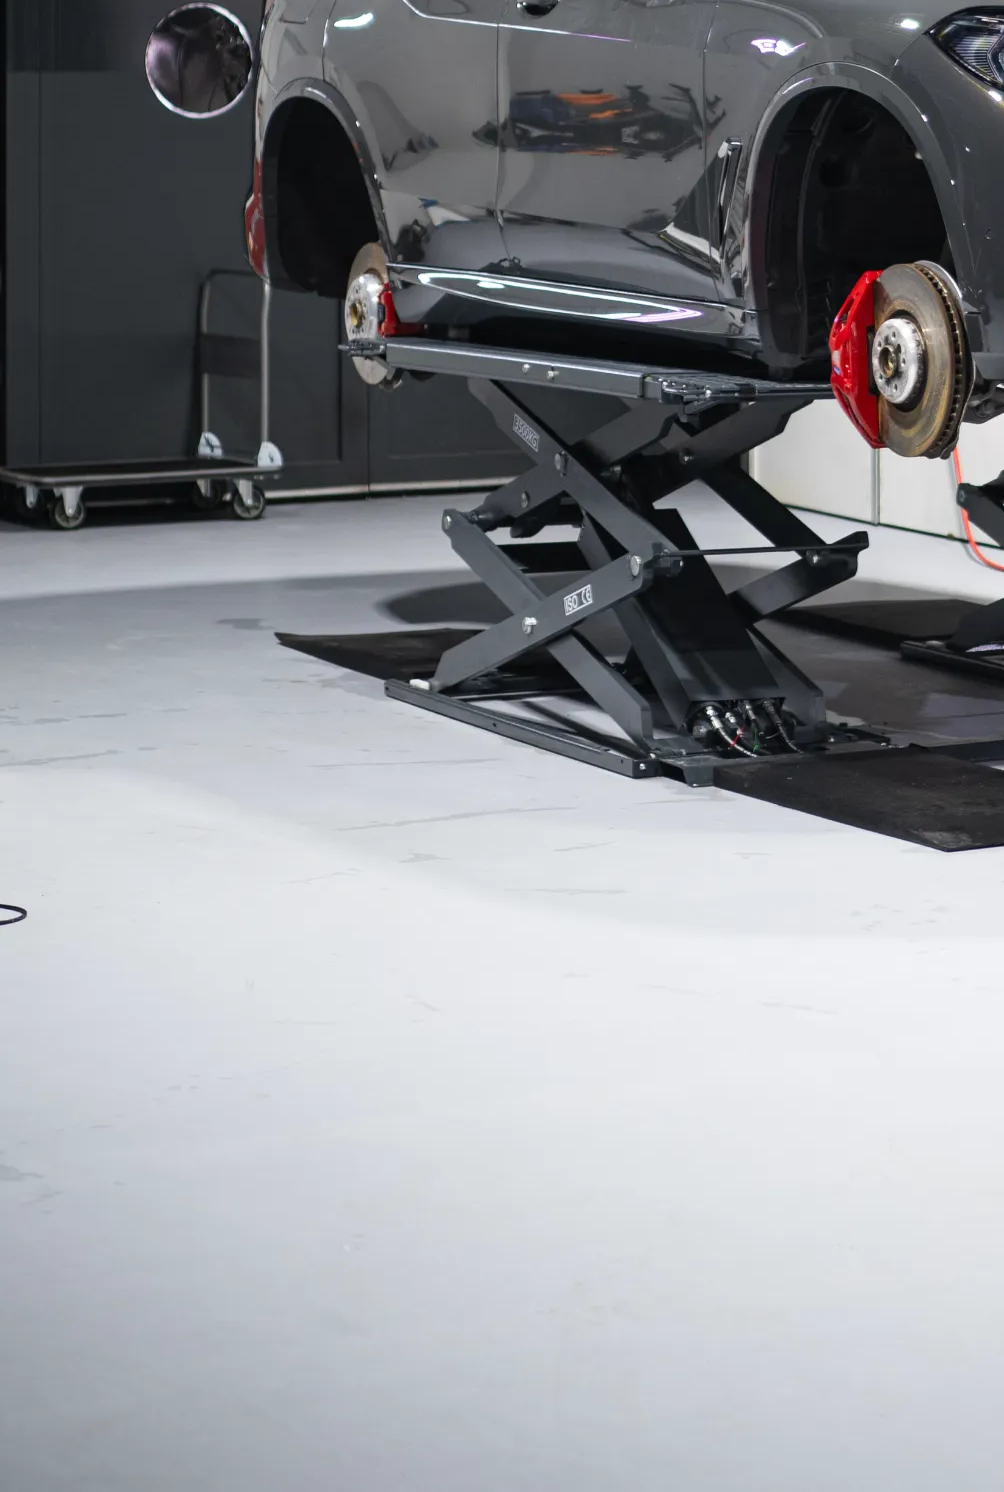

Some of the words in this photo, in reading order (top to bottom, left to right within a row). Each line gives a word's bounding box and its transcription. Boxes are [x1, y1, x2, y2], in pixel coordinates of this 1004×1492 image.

[514, 418, 538, 448] 3500KG
[565, 594, 578, 612] ISO
[581, 588, 591, 604] CE
